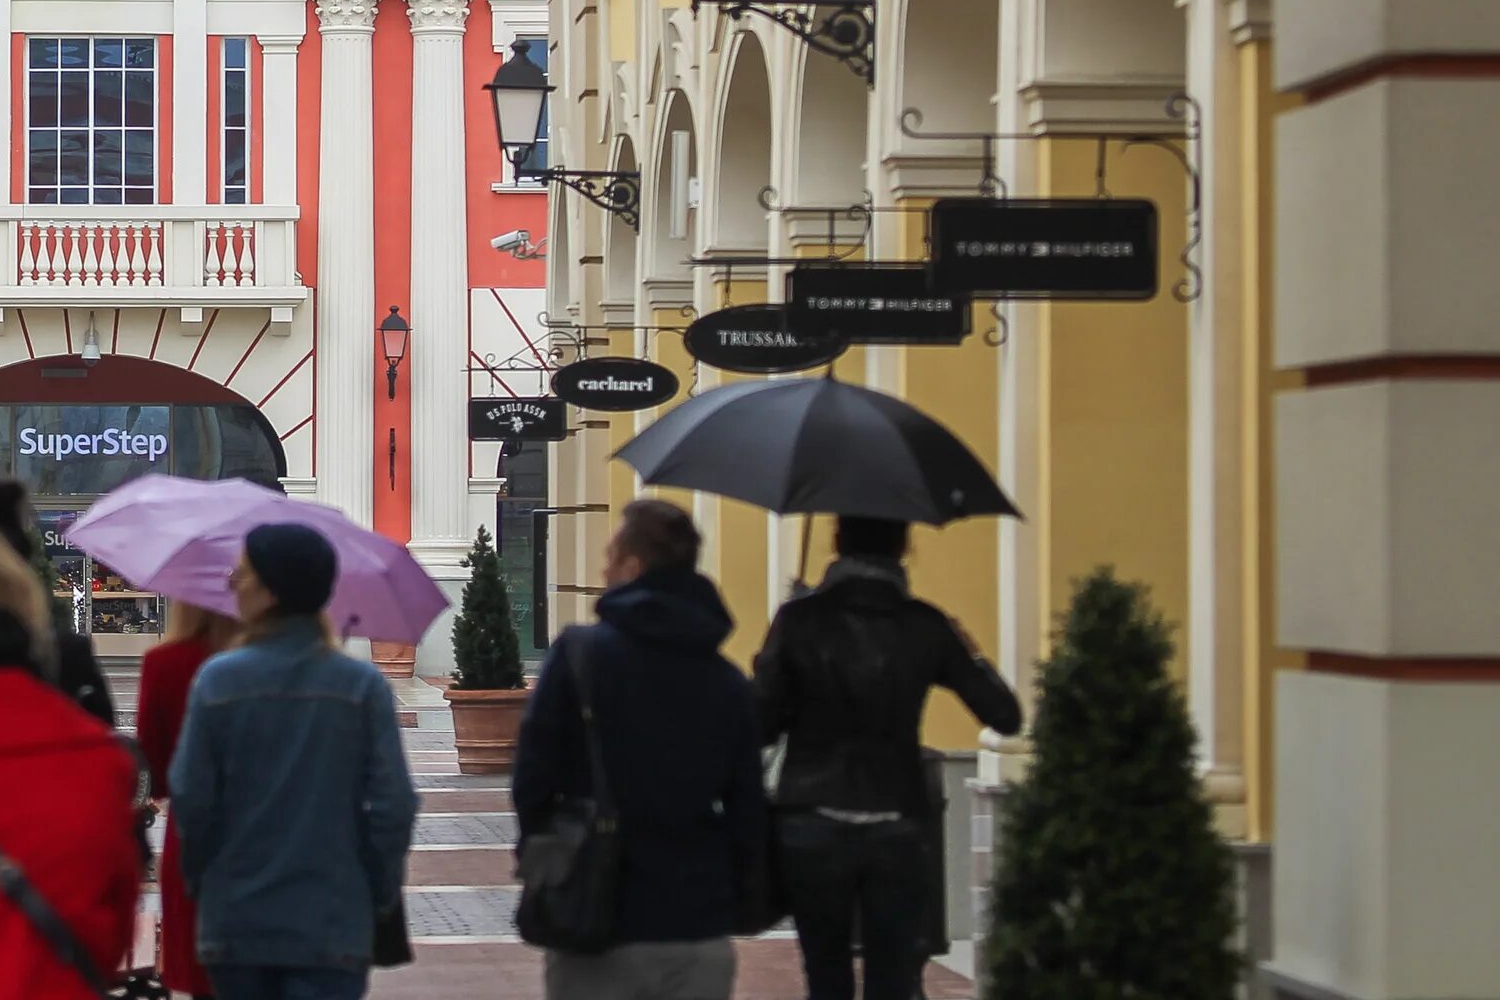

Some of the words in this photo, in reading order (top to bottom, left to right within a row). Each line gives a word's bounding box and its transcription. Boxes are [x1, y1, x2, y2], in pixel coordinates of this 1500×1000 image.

[956, 241, 1027, 257] TOMMY
[1052, 242, 1134, 257] HILFIGER
[807, 297, 866, 310] TOMMY
[885, 299, 952, 311] HILFIGER
[717, 329, 798, 346] TRUSSAR
[578, 375, 654, 391] cacharel
[500, 402, 522, 414] POLO
[20, 427, 168, 461] SuperStep
